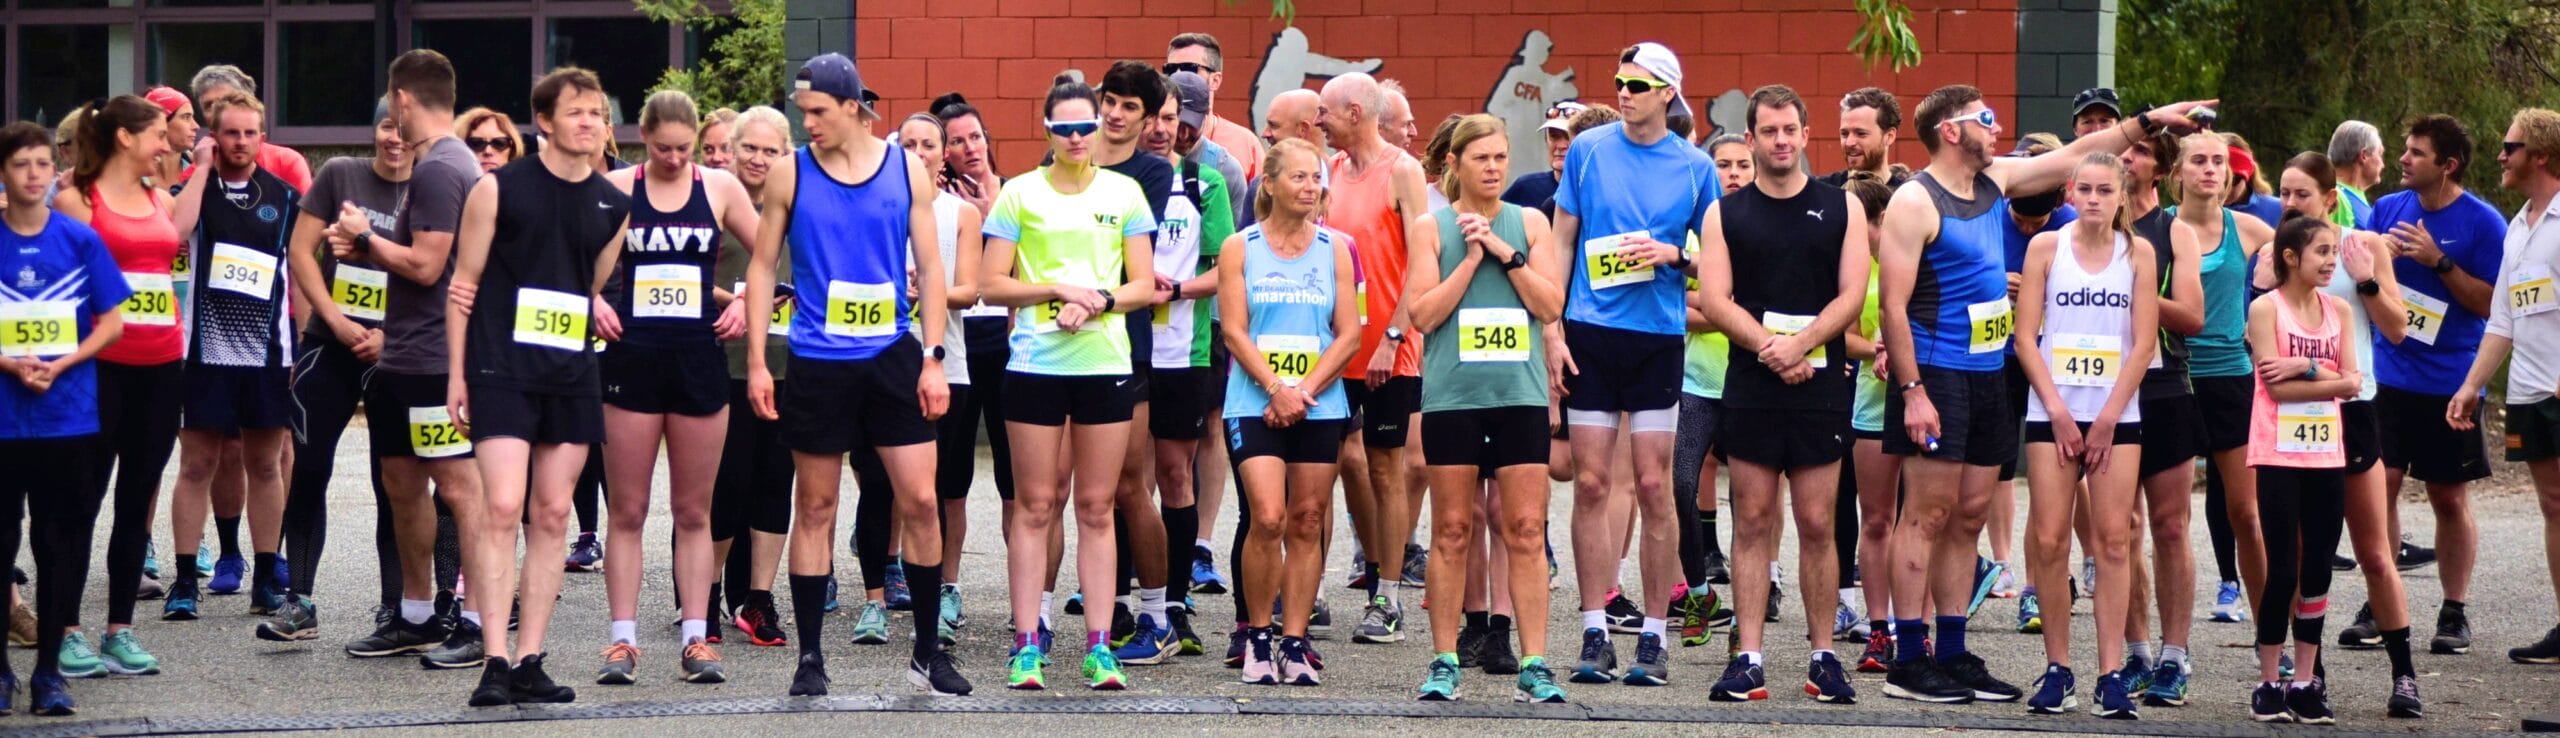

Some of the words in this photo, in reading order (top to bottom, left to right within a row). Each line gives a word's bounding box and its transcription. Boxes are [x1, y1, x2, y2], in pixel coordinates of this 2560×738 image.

[1514, 81, 1542, 103] CFA
[1094, 213, 1119, 225] VIC
[626, 227, 713, 252] NAVY
[223, 263, 259, 285] 394
[128, 290, 167, 314] 530
[345, 283, 383, 309] 521
[649, 287, 687, 306] 350
[2056, 287, 2129, 309] adidas
[2515, 287, 2540, 307] 317
[534, 308, 572, 335] 519
[843, 302, 881, 325] 516
[2406, 310, 2426, 331] 34
[16, 320, 60, 344] 539
[1474, 326, 1517, 349] 548
[1984, 315, 2007, 341] 518
[1268, 352, 1308, 376] 540
[2066, 356, 2104, 377] 419
[420, 422, 460, 447] 522
[2294, 423, 2329, 442] 413
